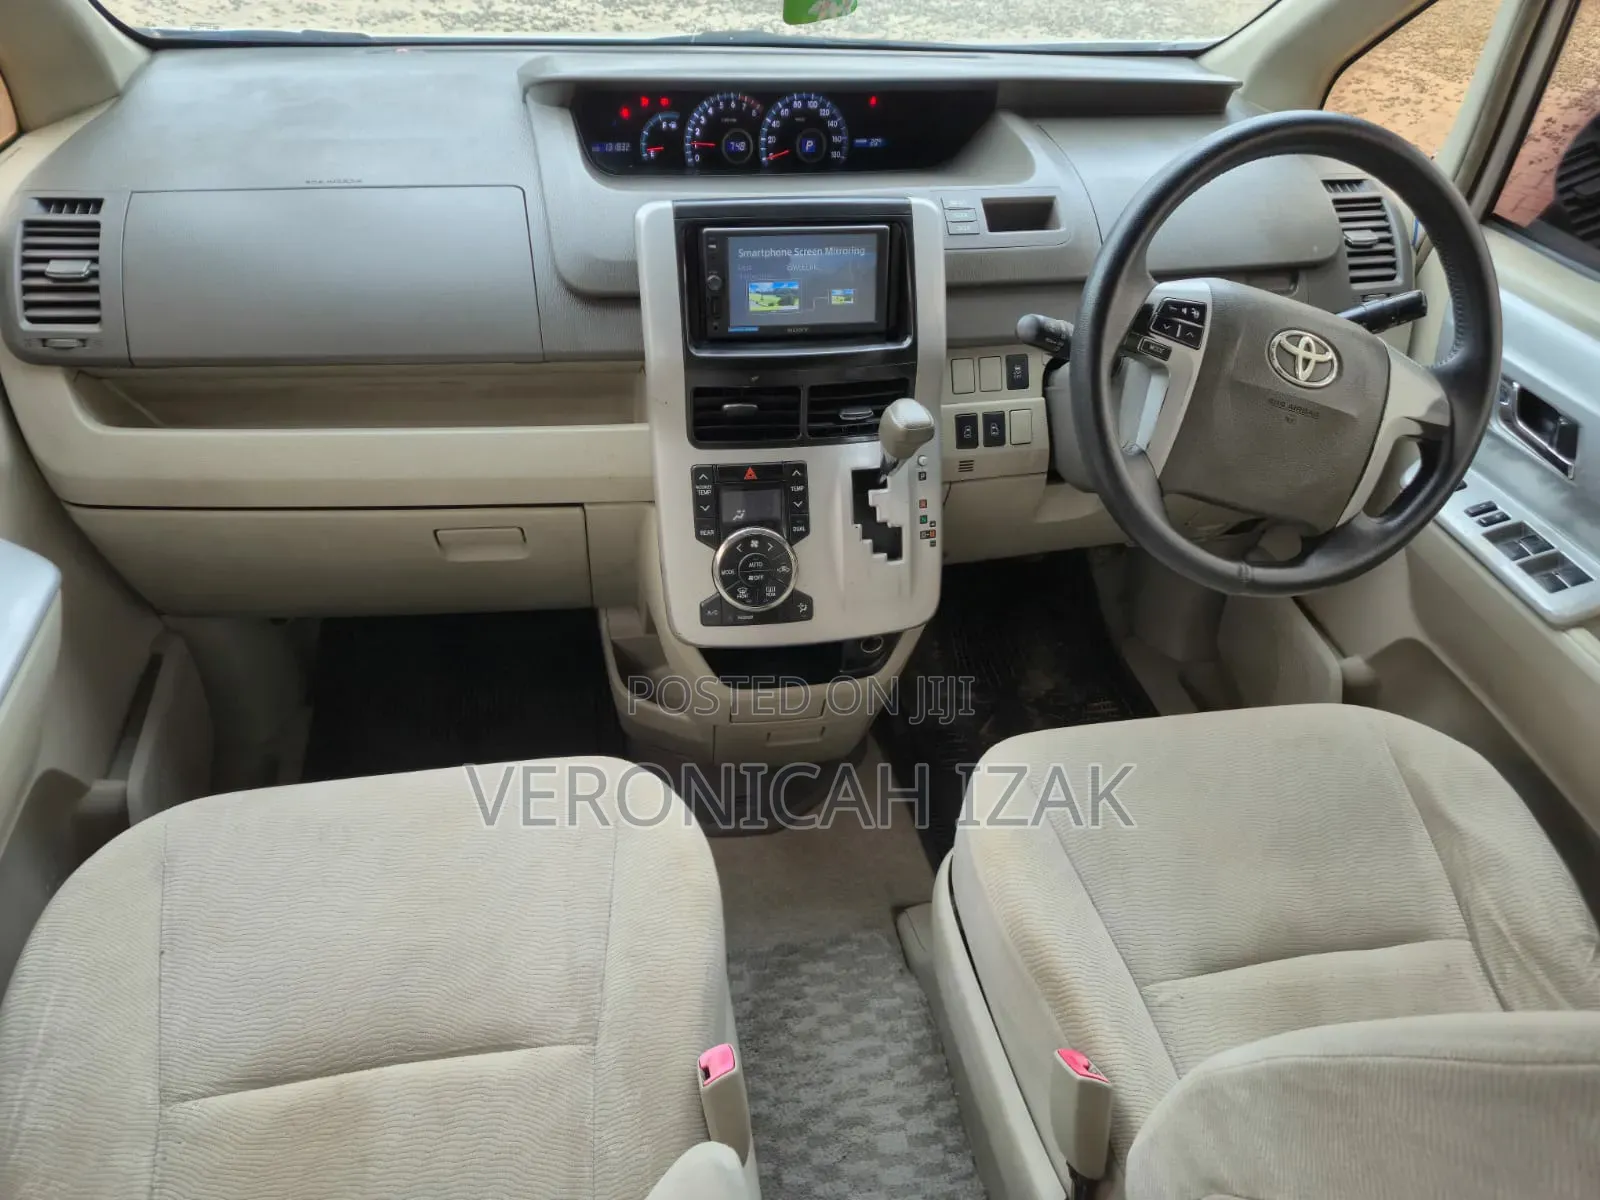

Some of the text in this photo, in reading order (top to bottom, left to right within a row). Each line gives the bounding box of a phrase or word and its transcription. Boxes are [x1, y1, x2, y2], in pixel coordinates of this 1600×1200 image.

[805, 140, 814, 152] P
[738, 247, 792, 258] Smartphone
[794, 247, 822, 256] Screen
